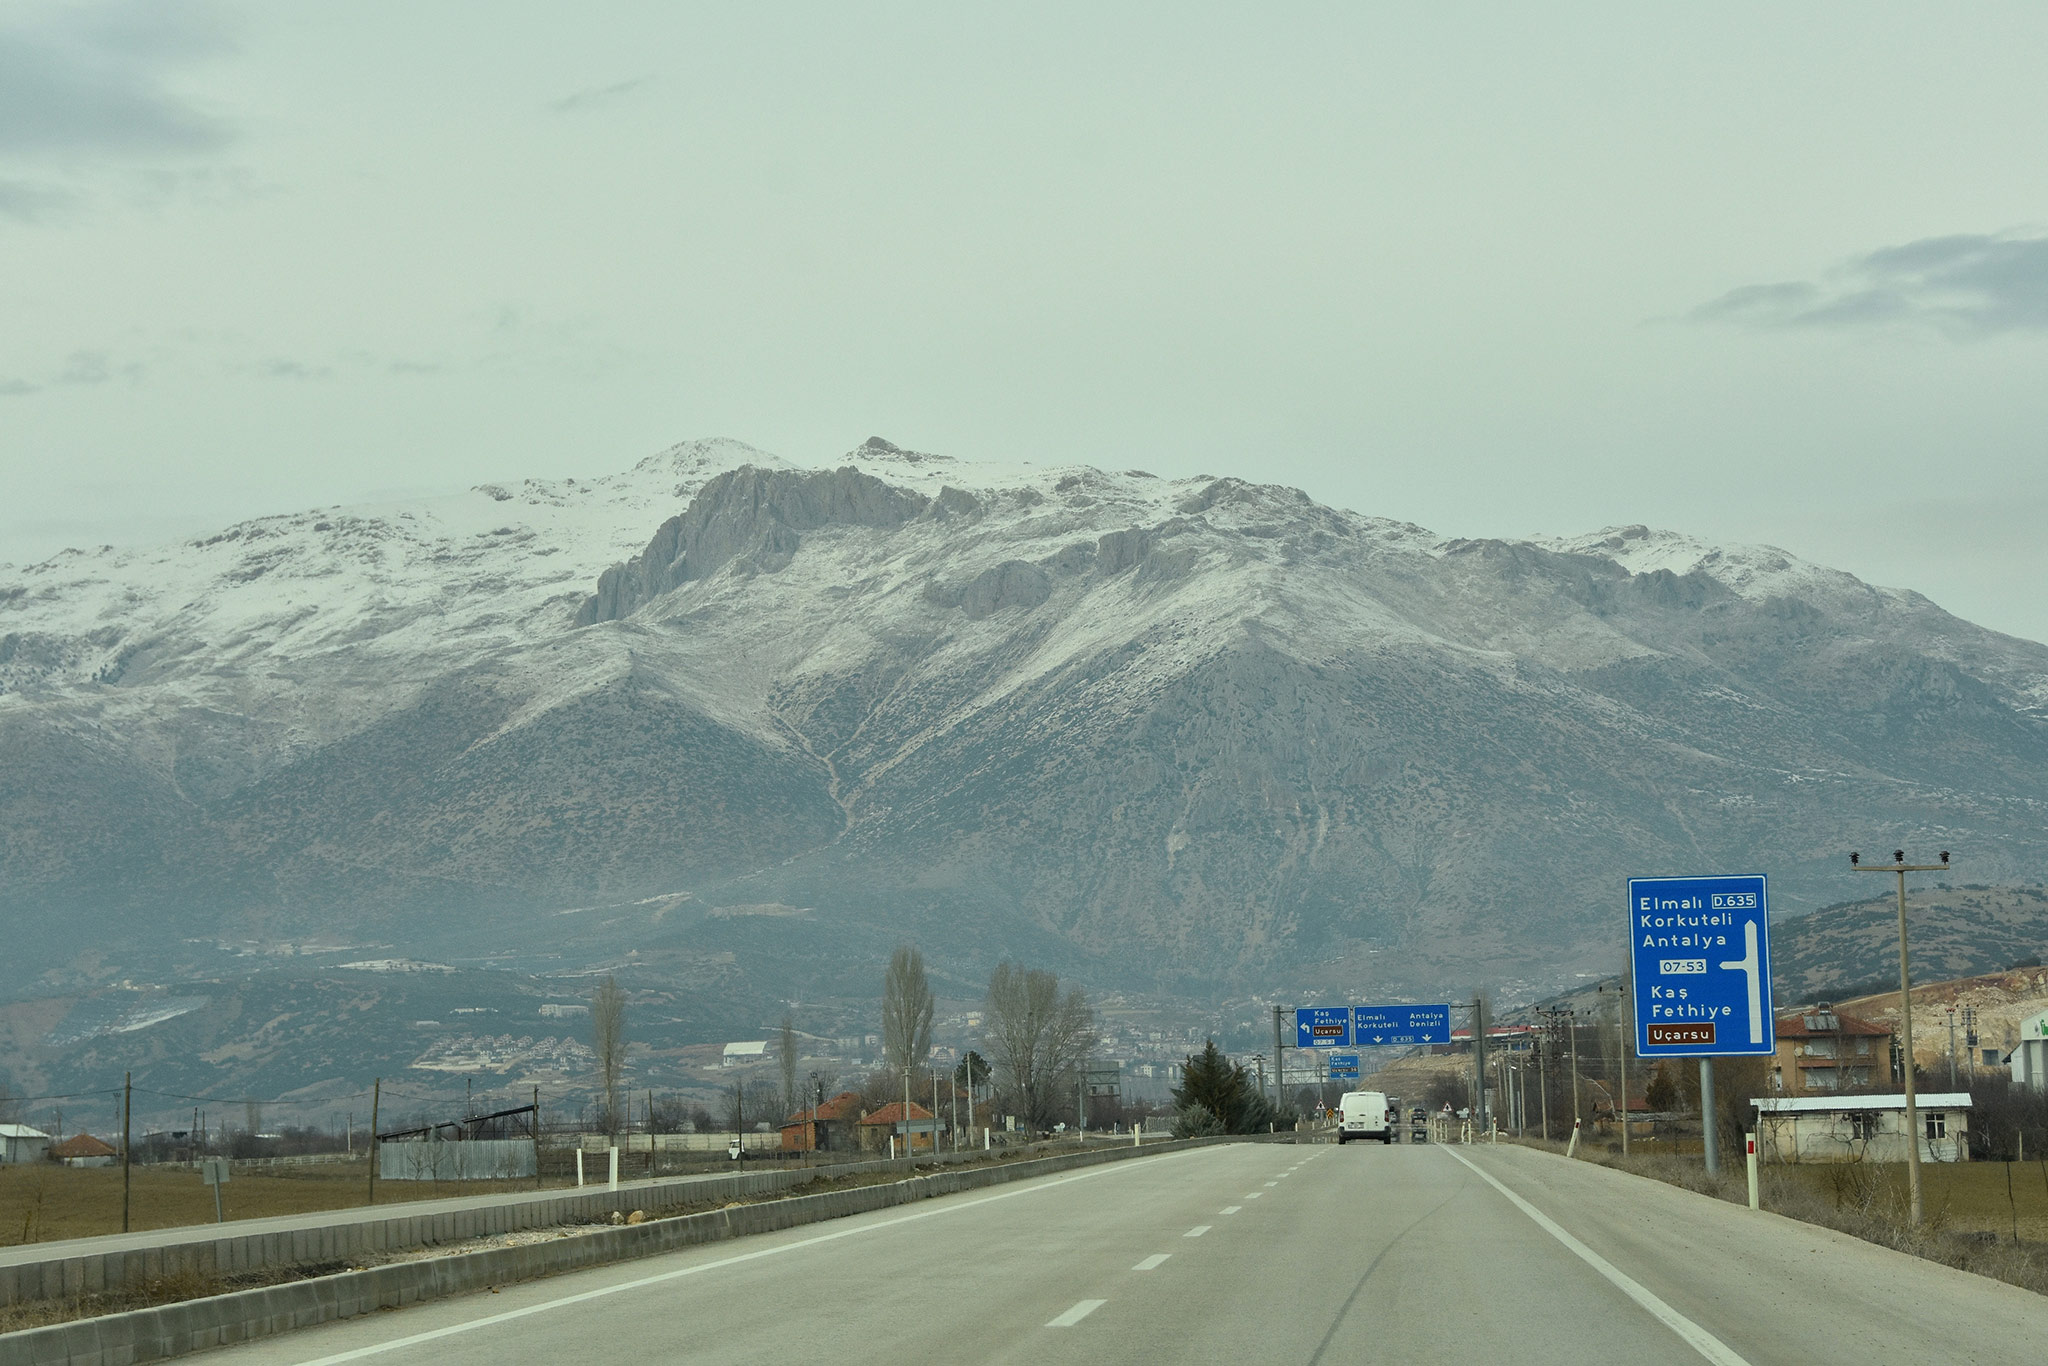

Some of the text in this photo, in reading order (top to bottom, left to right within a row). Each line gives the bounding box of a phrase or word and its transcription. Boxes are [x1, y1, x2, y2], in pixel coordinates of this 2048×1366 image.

[1640, 895, 1755, 910] Elmalı D.635
[1641, 912, 1733, 928] Korkuteli
[1643, 933, 1727, 950] Antalya
[1663, 961, 1705, 973] 07-53
[1651, 985, 1688, 1000] Kaş
[1410, 1012, 1444, 1020] Antalya
[1652, 1004, 1732, 1020] Fethiye
[1653, 1029, 1709, 1042] Uçarsu
